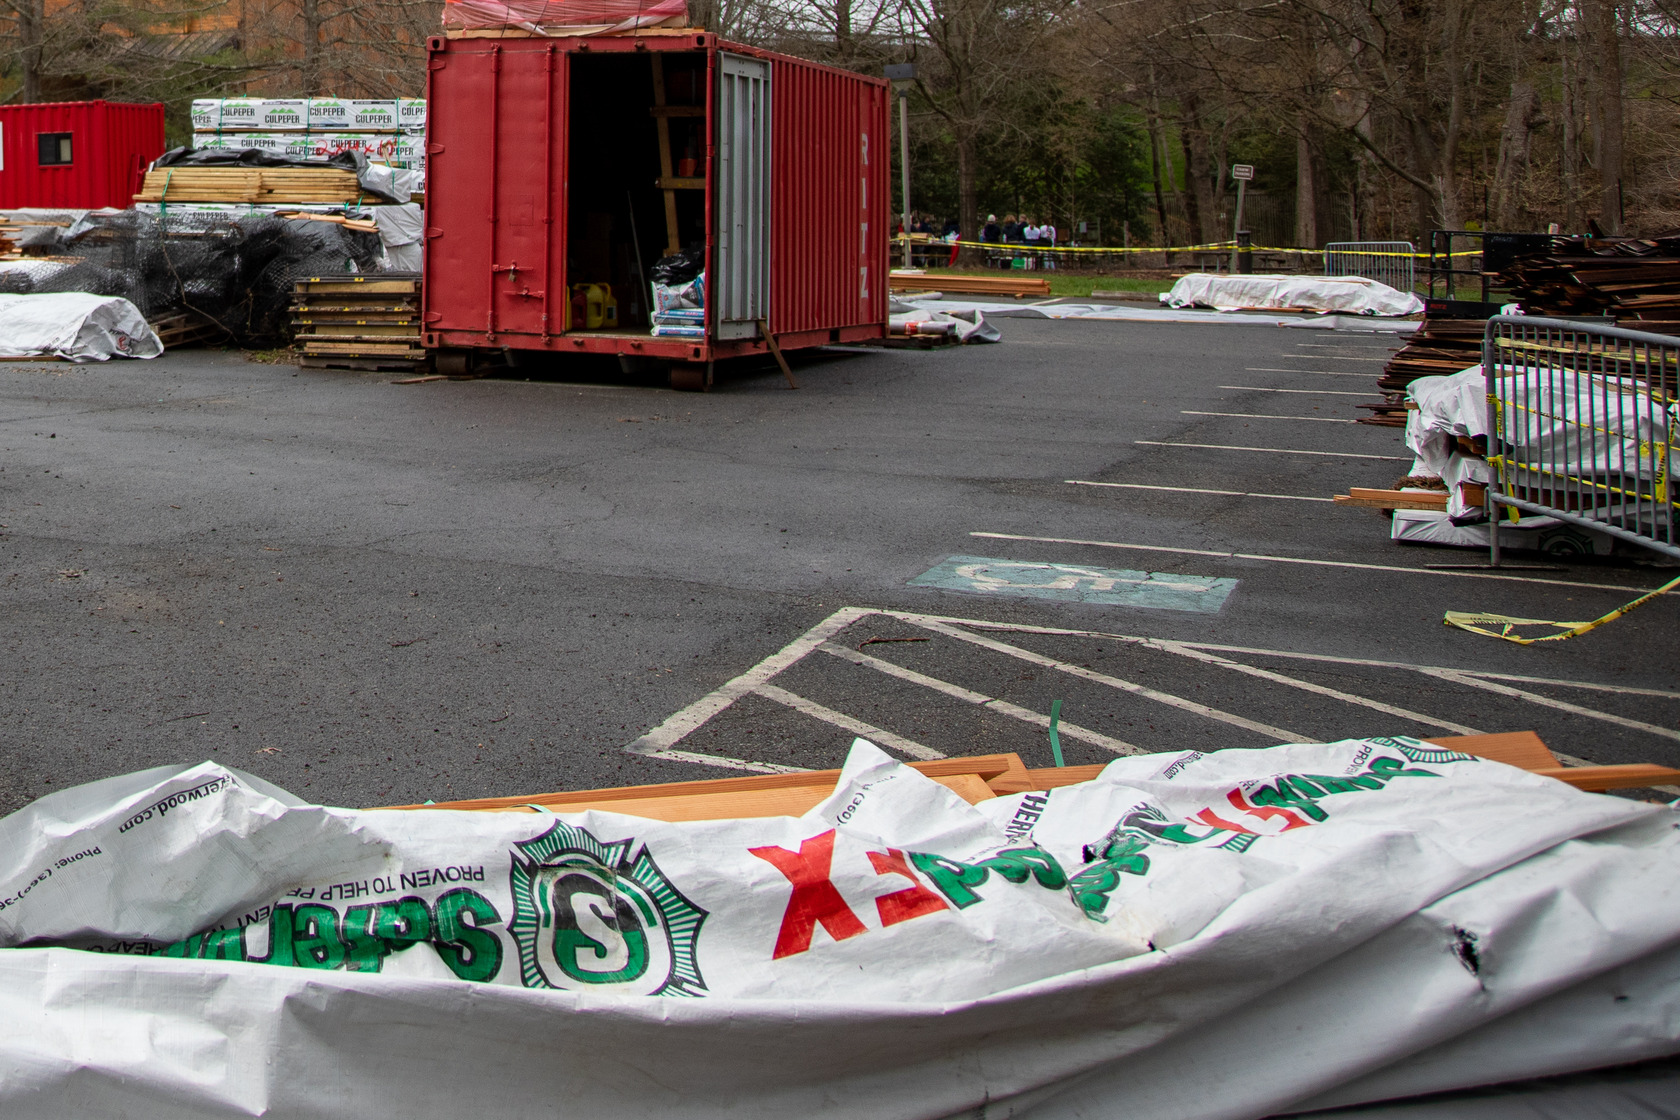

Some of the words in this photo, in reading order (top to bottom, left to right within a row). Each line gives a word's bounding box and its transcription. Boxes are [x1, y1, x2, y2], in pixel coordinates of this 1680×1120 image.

[222, 107, 256, 117] CULPEPER
[310, 107, 346, 116] CULPEPER
[264, 114, 300, 124] CULPEPER
[355, 114, 392, 124] CULPEPER
[241, 139, 276, 148] CULPEPER
[860, 133, 869, 298] RITZ
[55, 846, 103, 870] Phone:
[402, 864, 485, 888] PROVEN
[319, 883, 371, 901] HELP
[372, 876, 396, 894] TO
